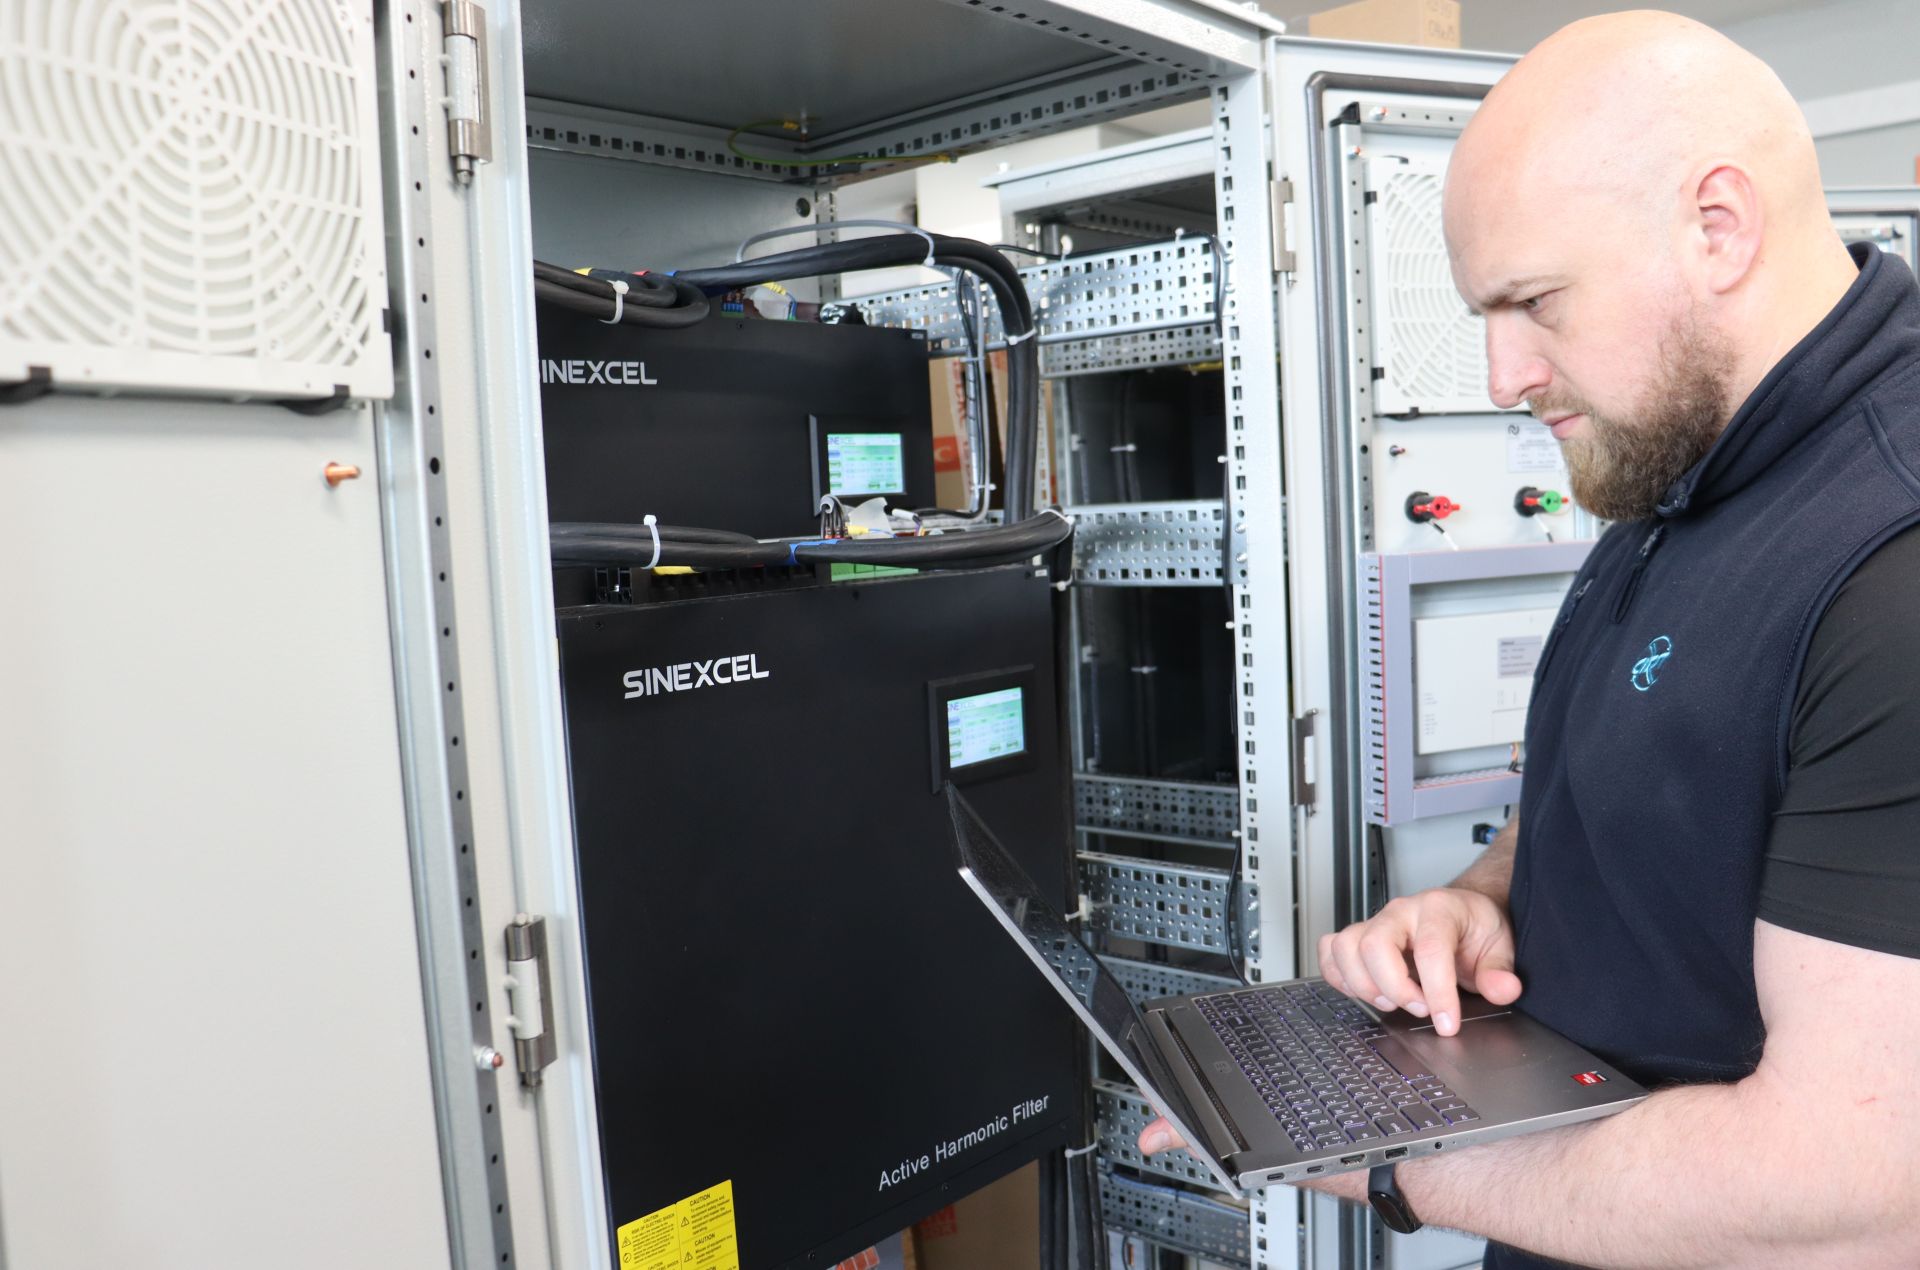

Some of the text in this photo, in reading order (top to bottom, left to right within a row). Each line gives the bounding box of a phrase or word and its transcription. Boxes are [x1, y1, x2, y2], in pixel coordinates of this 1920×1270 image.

[541, 359, 658, 385] INEXCEL
[622, 653, 770, 700] SINEXCEL
[878, 1095, 1049, 1192] Active Harmonic Filter
